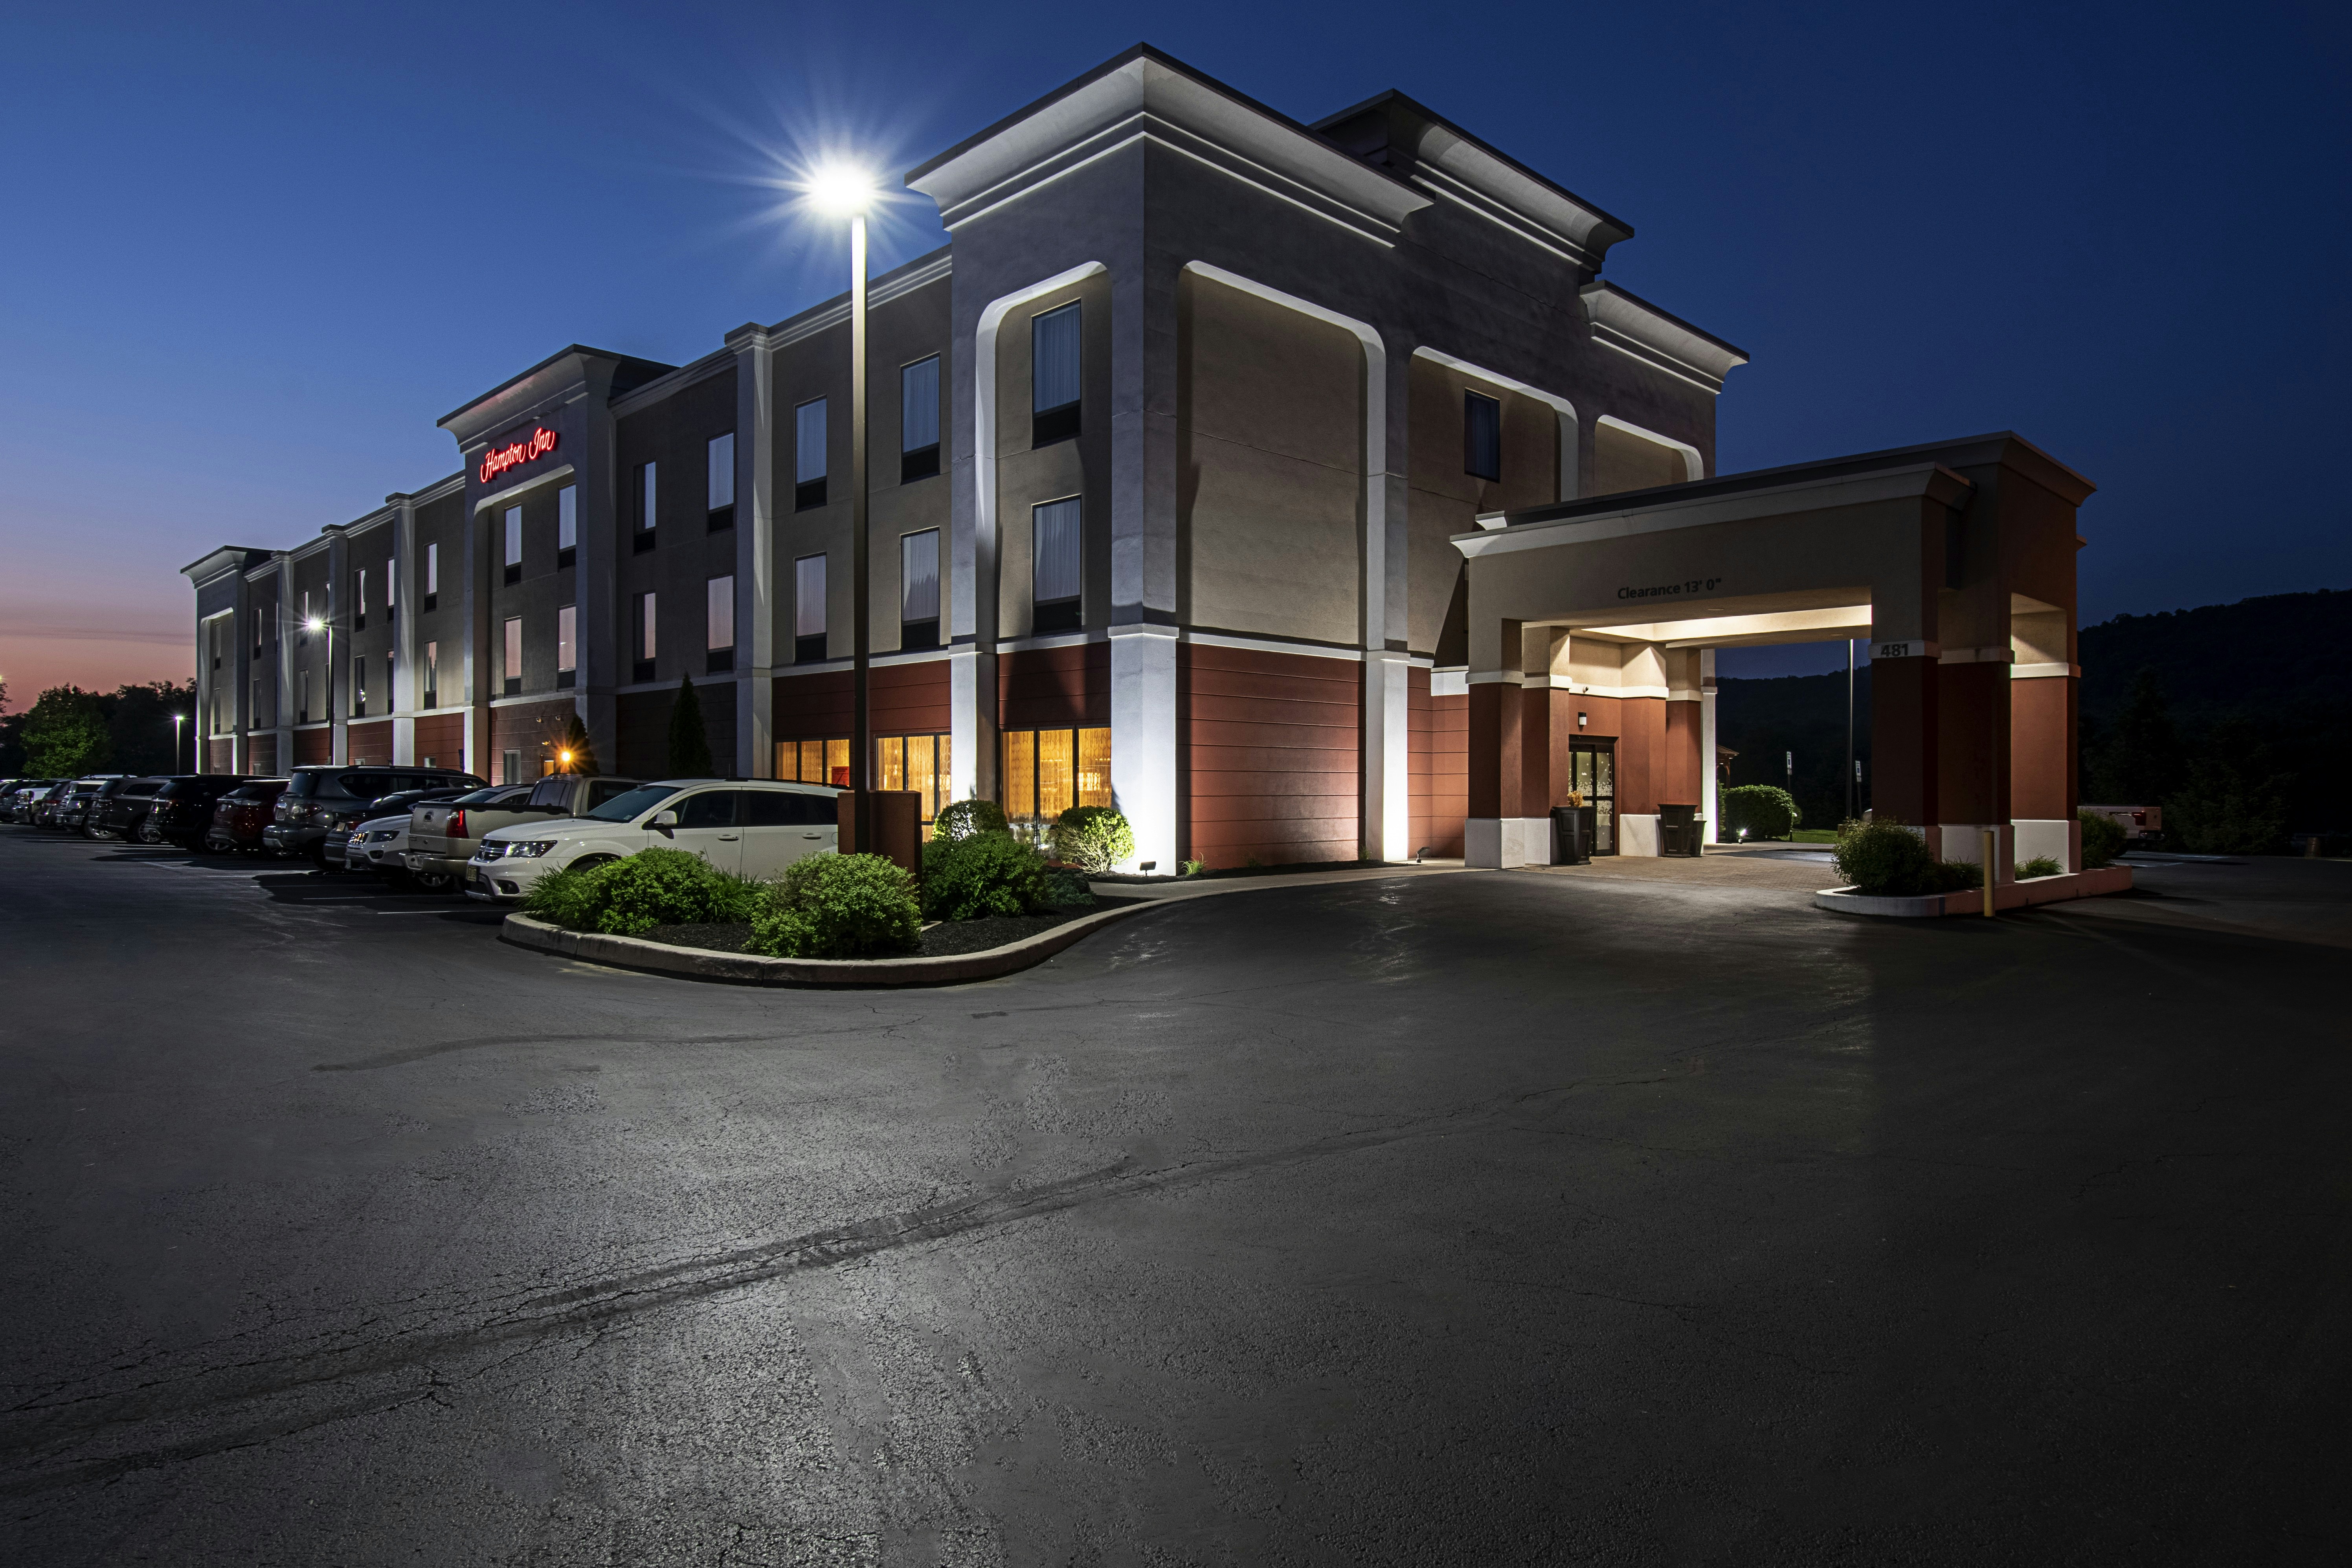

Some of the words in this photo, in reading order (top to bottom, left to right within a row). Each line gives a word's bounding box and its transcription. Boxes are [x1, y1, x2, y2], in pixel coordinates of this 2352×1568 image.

[480, 442, 526, 483] Hampton
[529, 427, 555, 460] Inn
[1617, 584, 1681, 599] Clearance
[1684, 580, 1702, 593] 13'
[1706, 578, 1721, 591] 0"
[1880, 643, 1909, 657] 481
